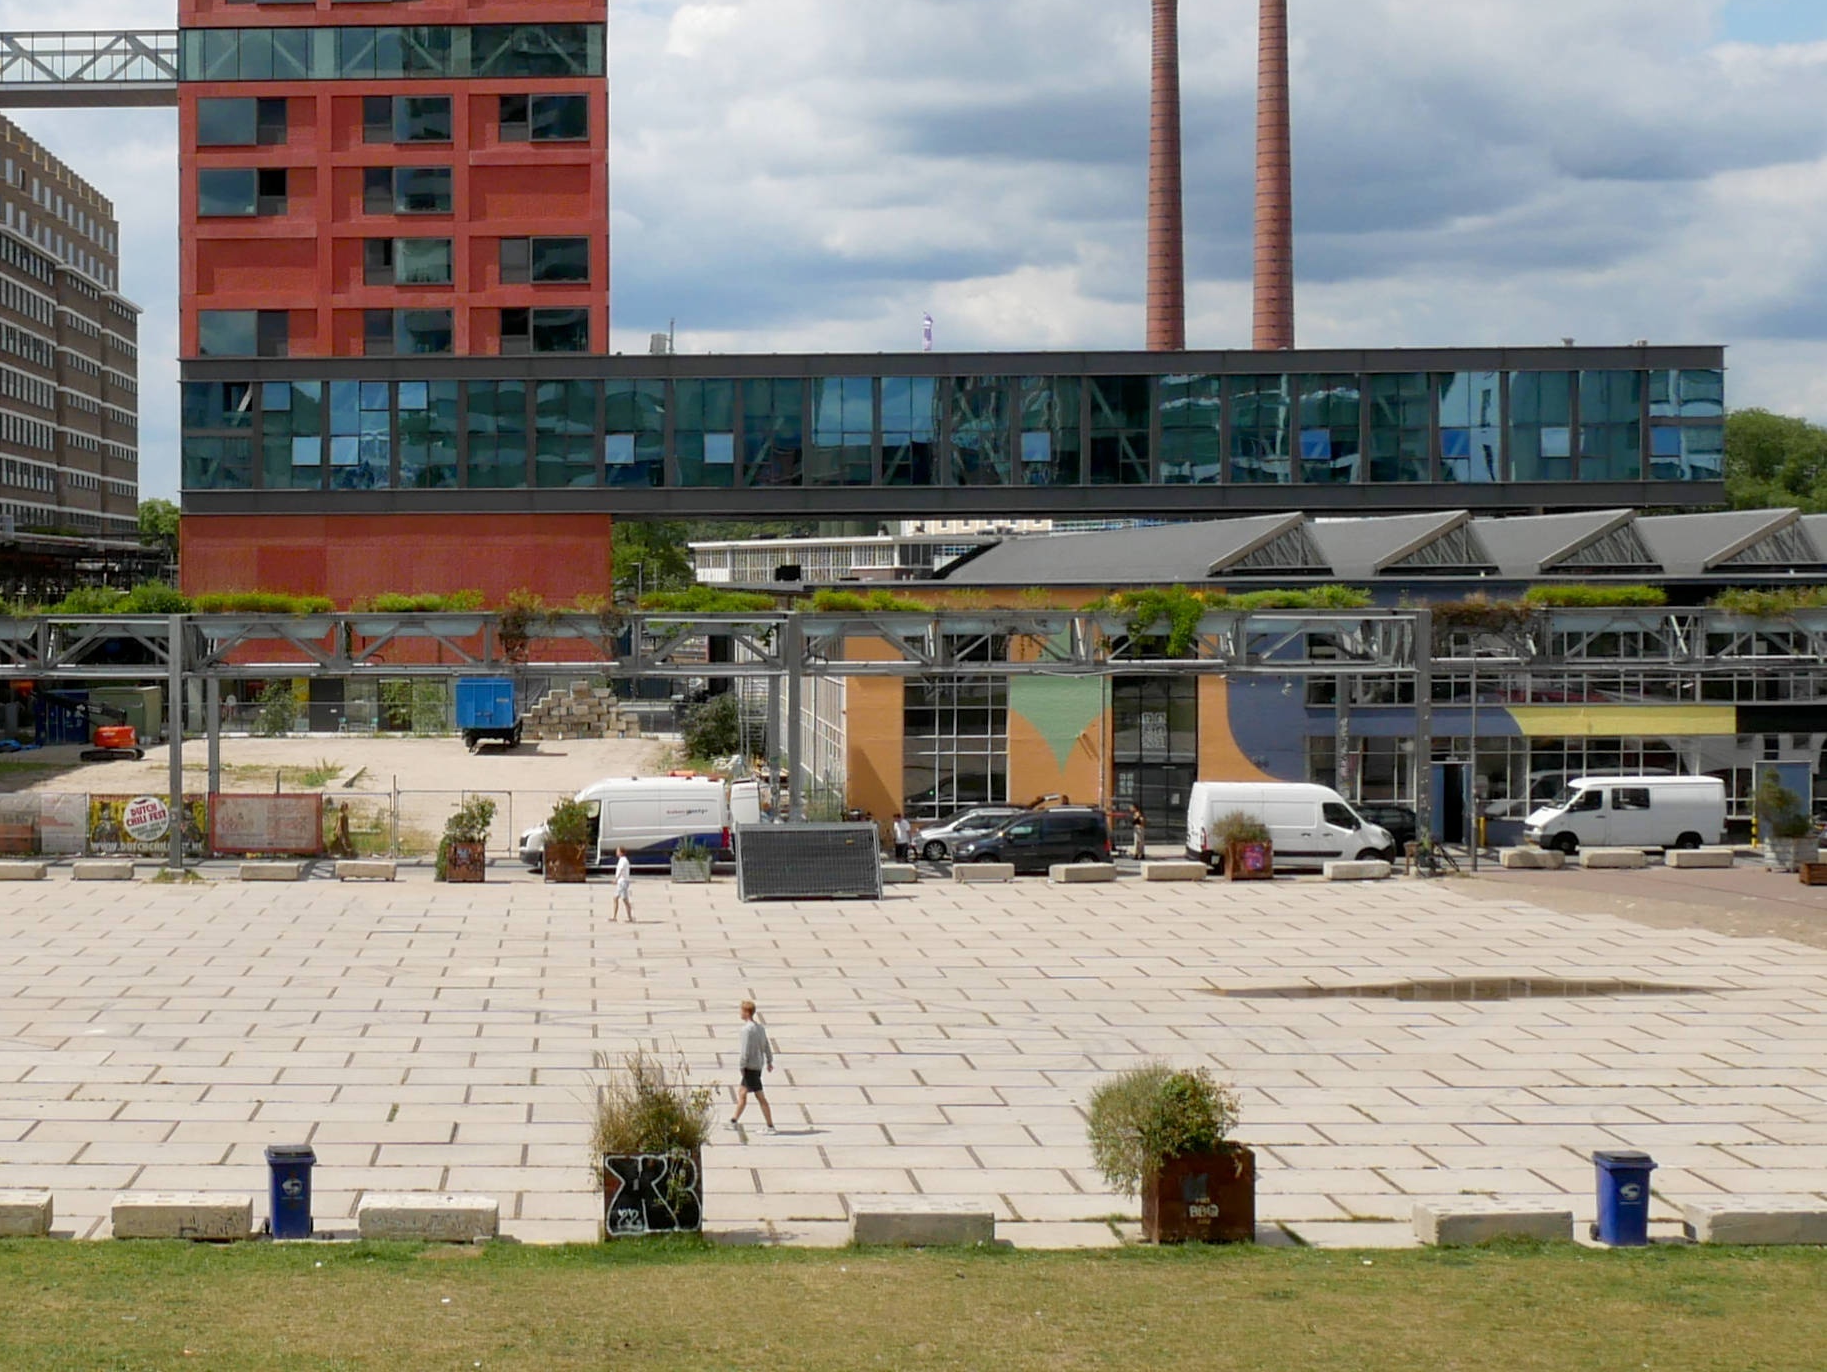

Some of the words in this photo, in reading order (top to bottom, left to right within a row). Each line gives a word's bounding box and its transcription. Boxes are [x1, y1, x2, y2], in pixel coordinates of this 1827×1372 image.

[130, 803, 158, 817] DUTCH
[126, 815, 147, 827] CHILI
[149, 809, 167, 822] FEST
[1189, 1204, 1219, 1218] BBQ
